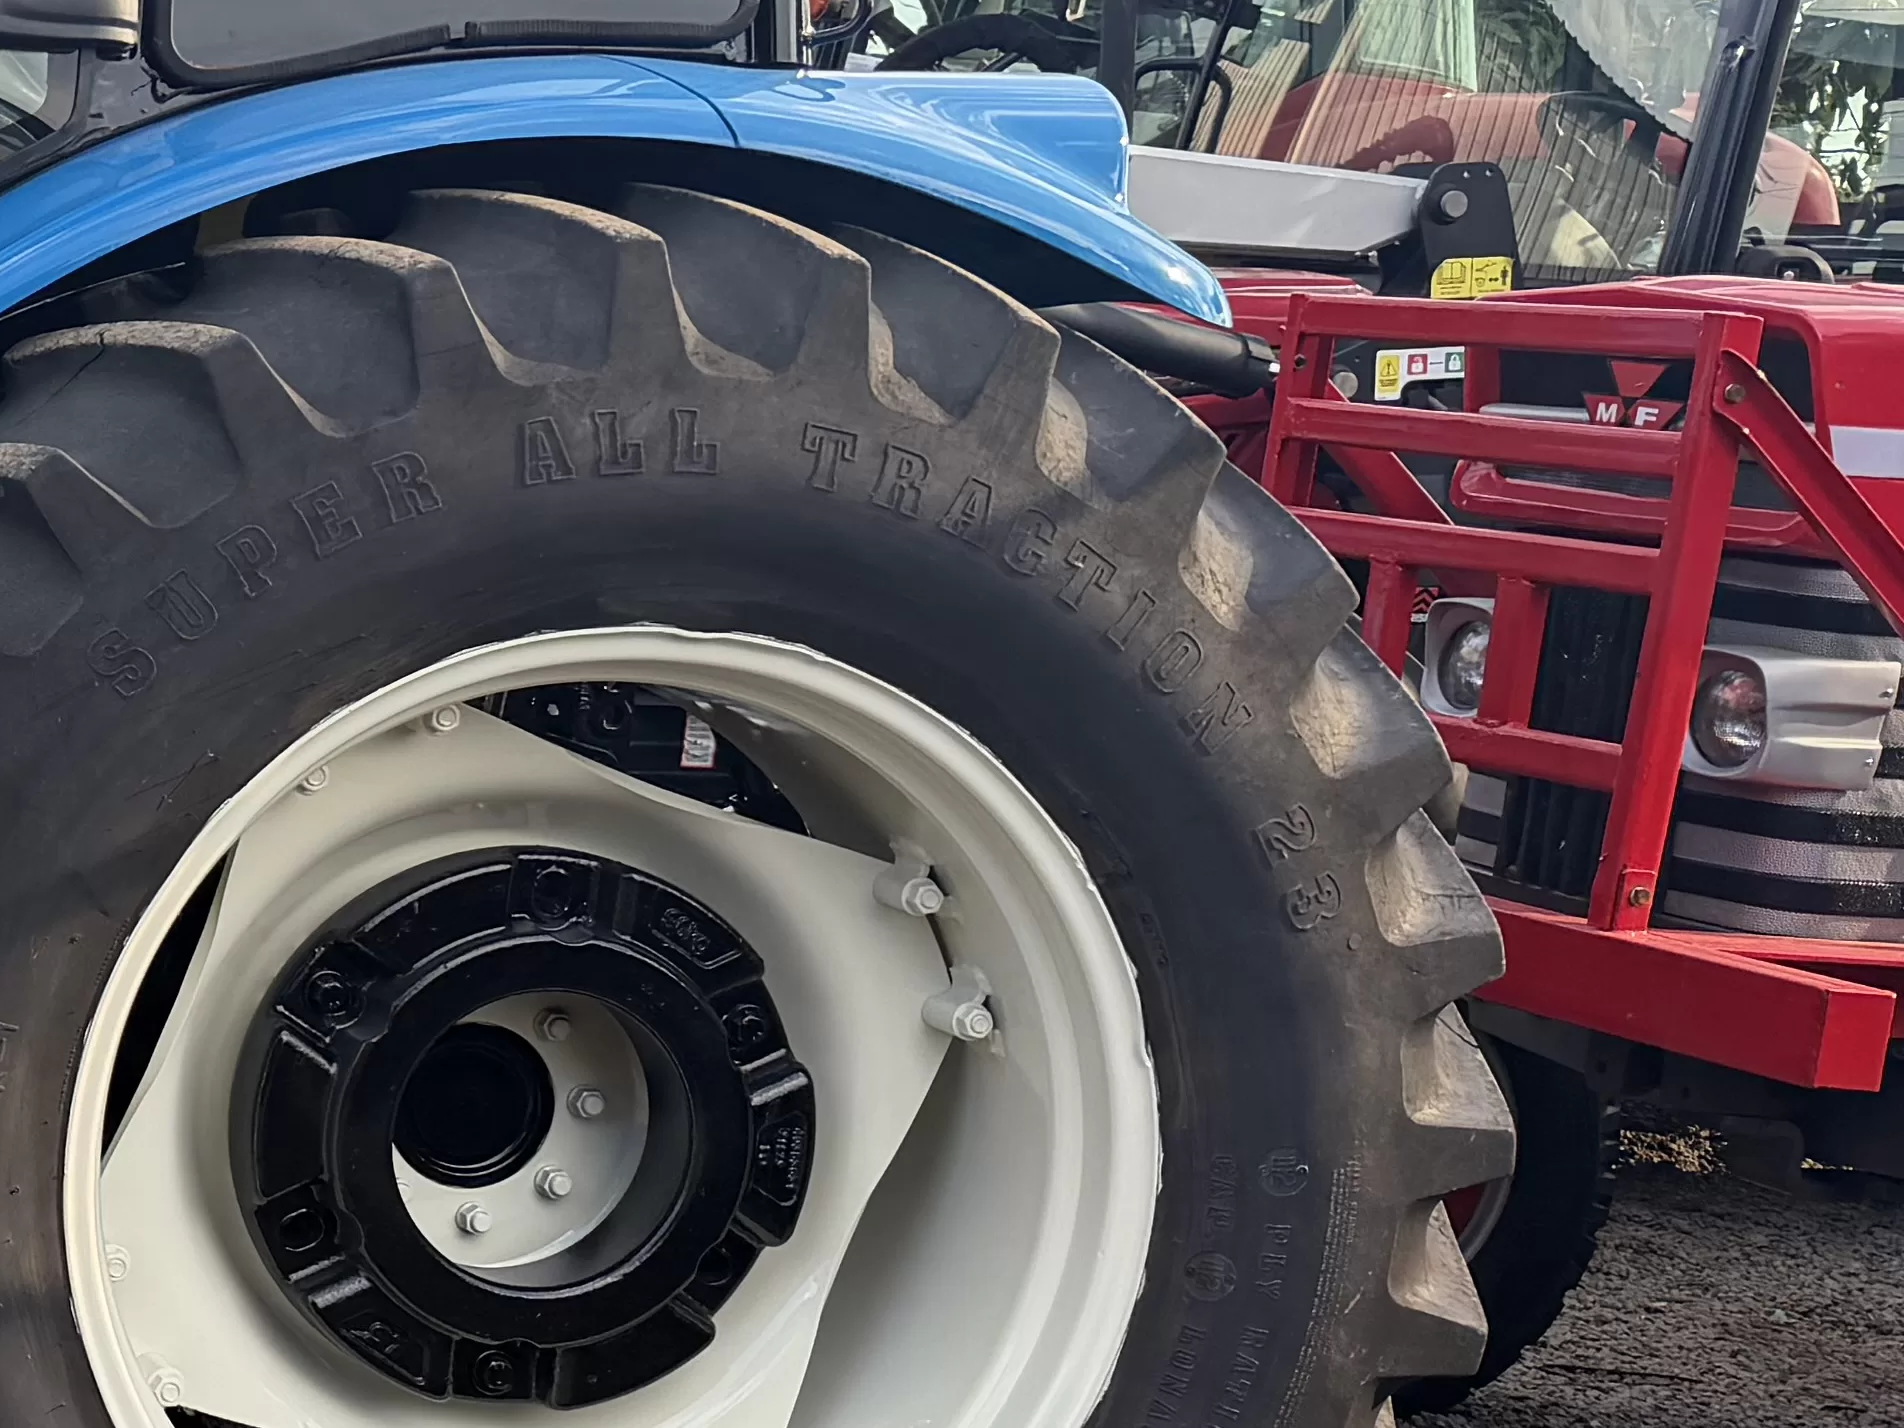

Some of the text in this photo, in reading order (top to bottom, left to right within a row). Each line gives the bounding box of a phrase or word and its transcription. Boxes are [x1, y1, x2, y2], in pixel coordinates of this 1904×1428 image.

[86, 450, 446, 698] SUPER
[520, 406, 722, 487] ALL
[798, 420, 1254, 756] TRACTION
[1251, 1222, 1293, 1301] PLY
